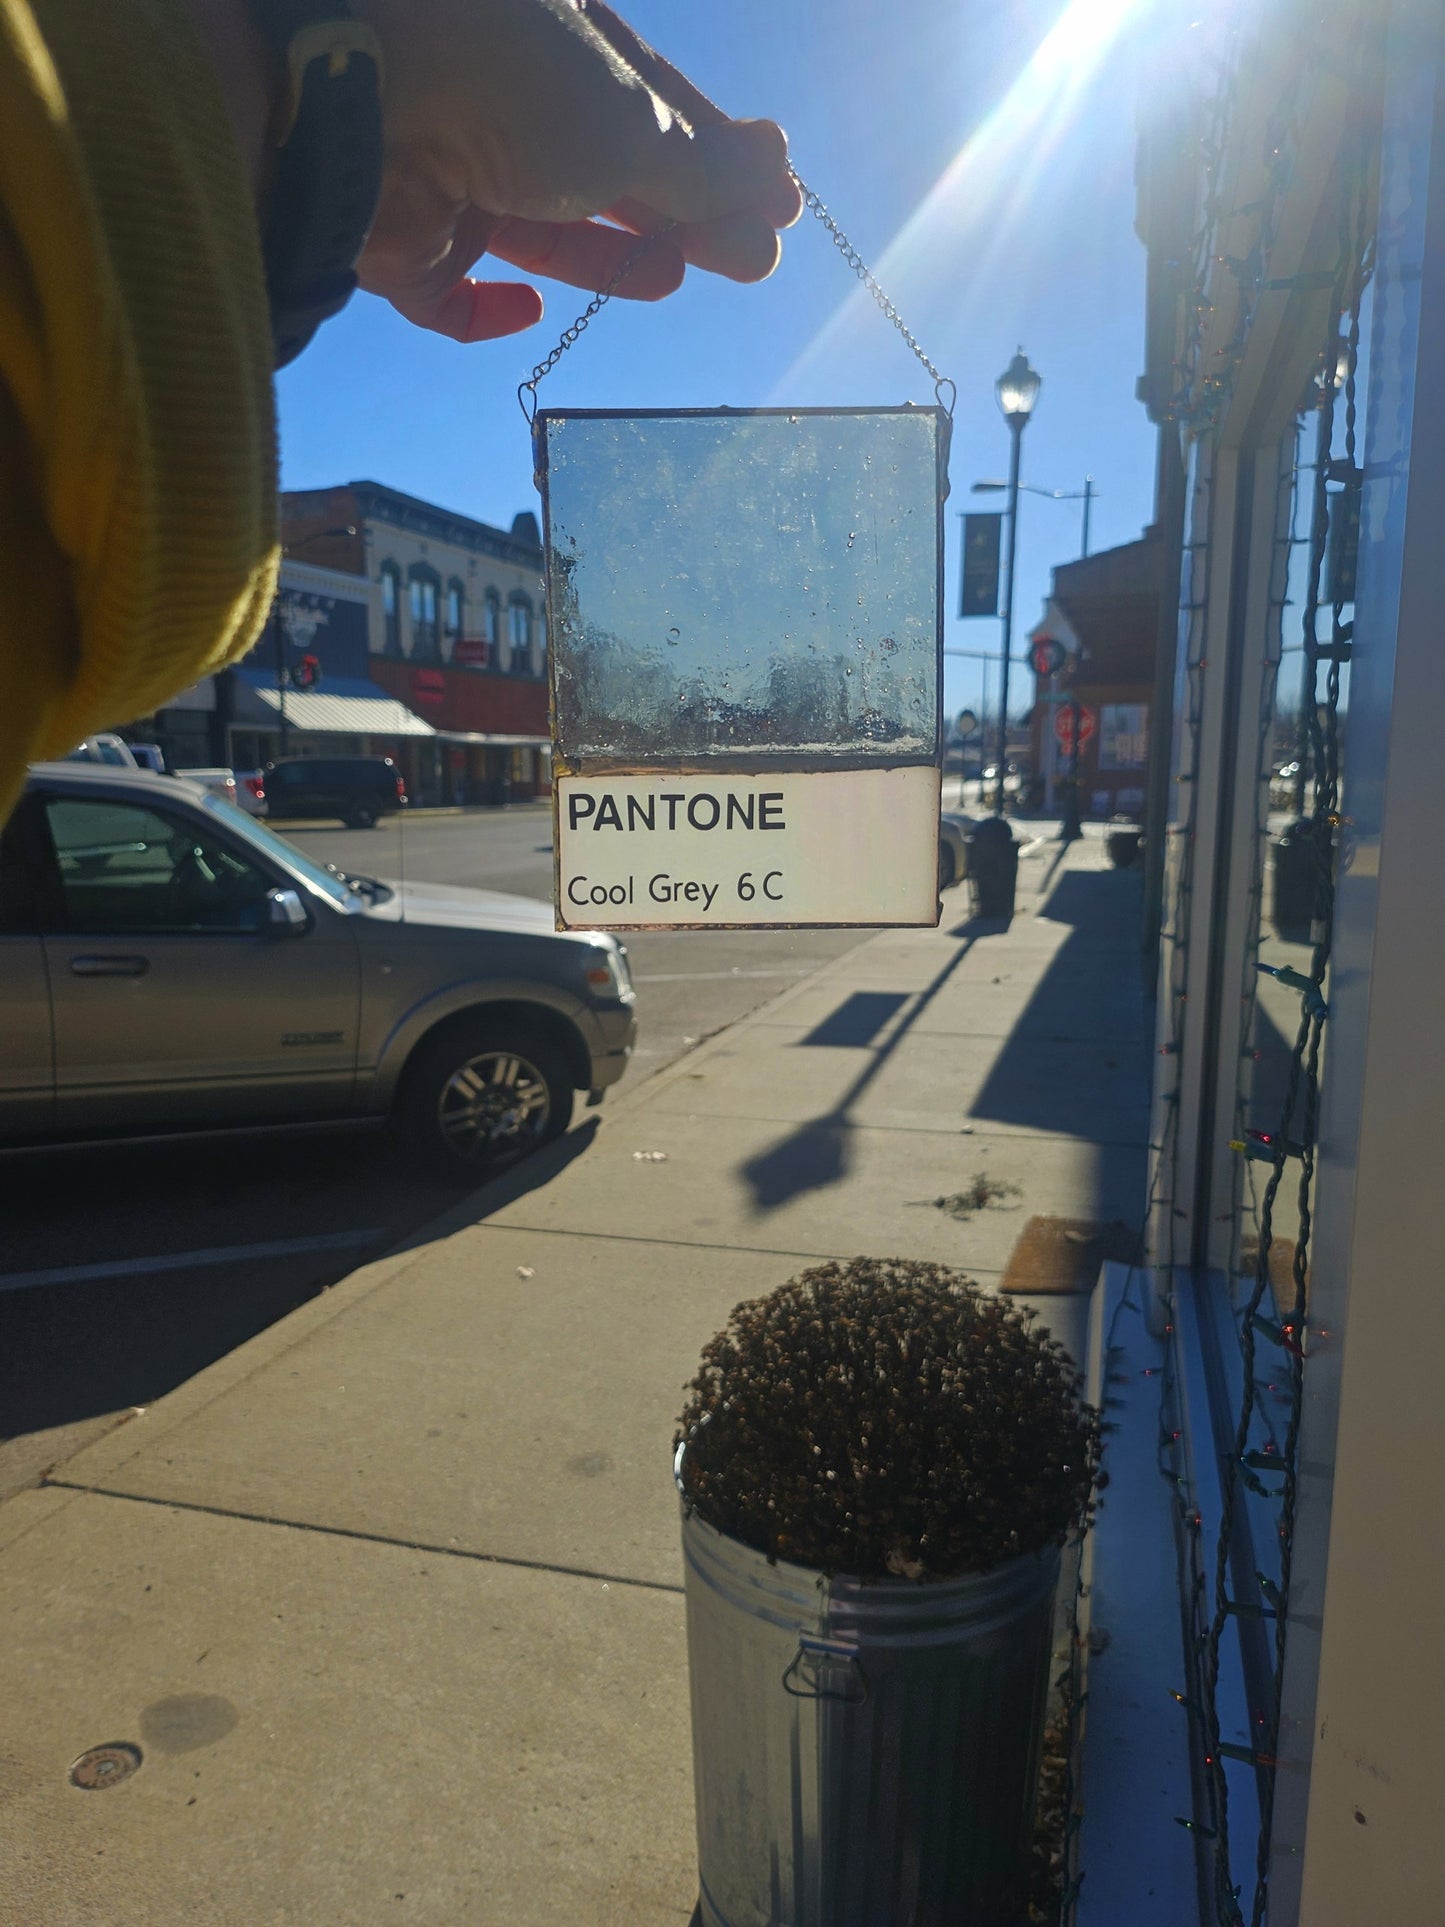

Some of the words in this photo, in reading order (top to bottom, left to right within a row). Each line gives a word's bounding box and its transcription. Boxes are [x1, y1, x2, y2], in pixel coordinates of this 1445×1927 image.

[568, 792, 786, 832] PANTONE
[567, 875, 634, 906] Cool
[648, 873, 720, 912] Grey
